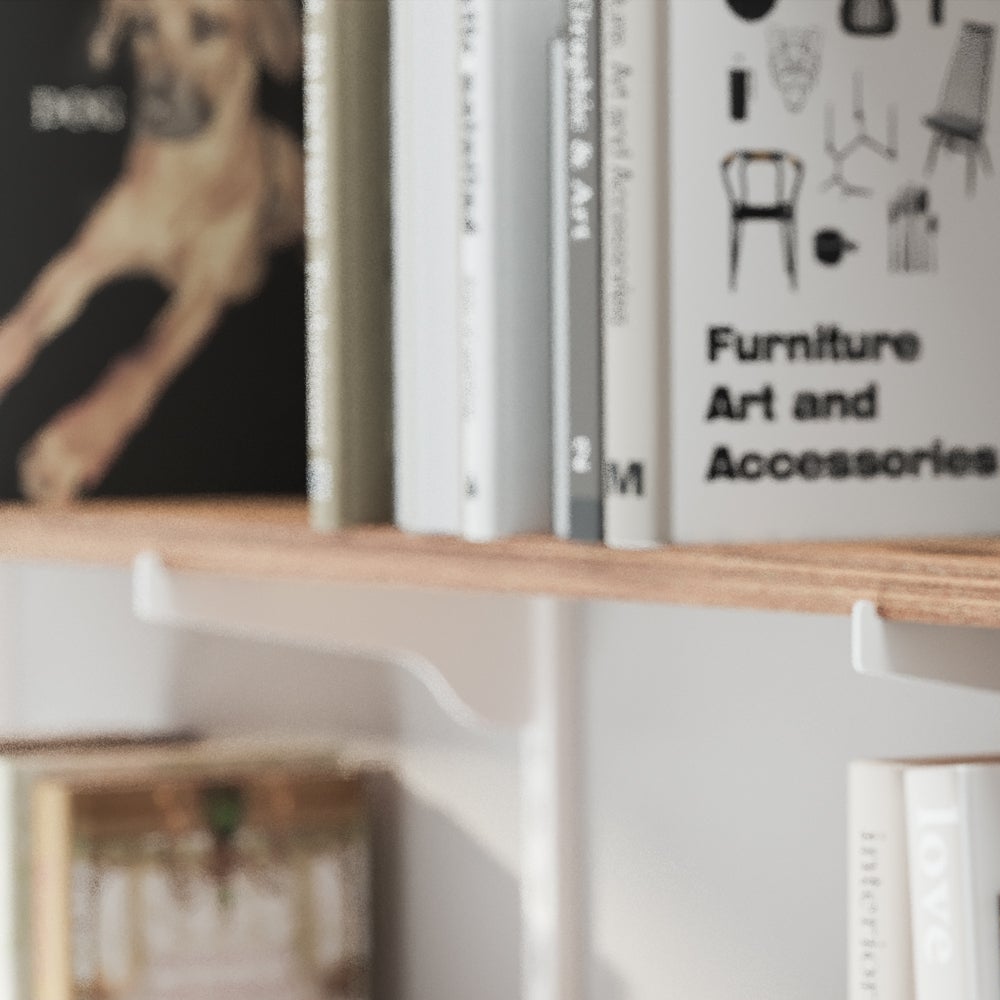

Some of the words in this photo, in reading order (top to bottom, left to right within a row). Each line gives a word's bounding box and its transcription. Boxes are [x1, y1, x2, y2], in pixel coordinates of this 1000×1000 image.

[706, 326, 921, 362] Furniture
[706, 385, 774, 421] Art
[792, 383, 878, 421] and
[706, 440, 999, 482] Accessories
[916, 803, 959, 966] love
